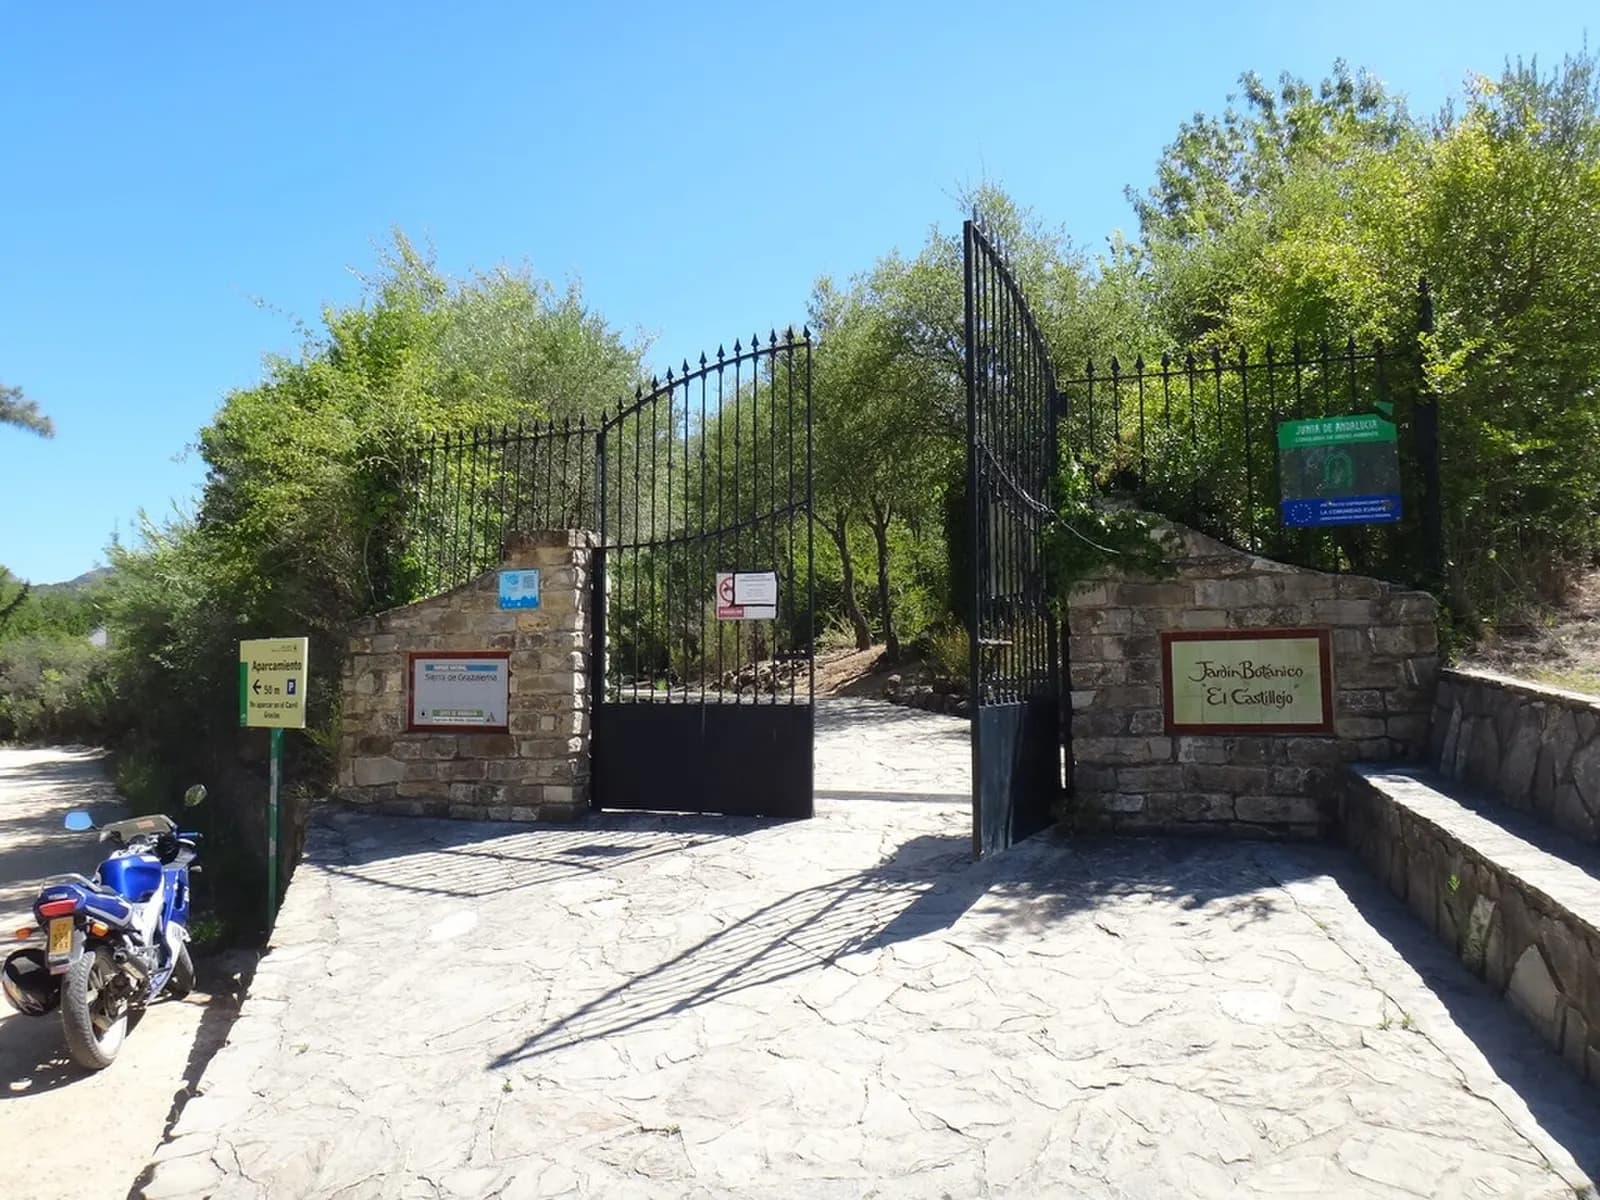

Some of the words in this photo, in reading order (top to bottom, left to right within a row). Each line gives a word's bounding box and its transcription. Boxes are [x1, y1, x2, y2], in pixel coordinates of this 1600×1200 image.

[1323, 422, 1333, 434] DE
[251, 661, 302, 673] Aparcamiento
[1239, 660, 1304, 680] Botánico
[447, 673, 457, 681] de
[264, 684, 272, 695] 50
[274, 687, 280, 695] m
